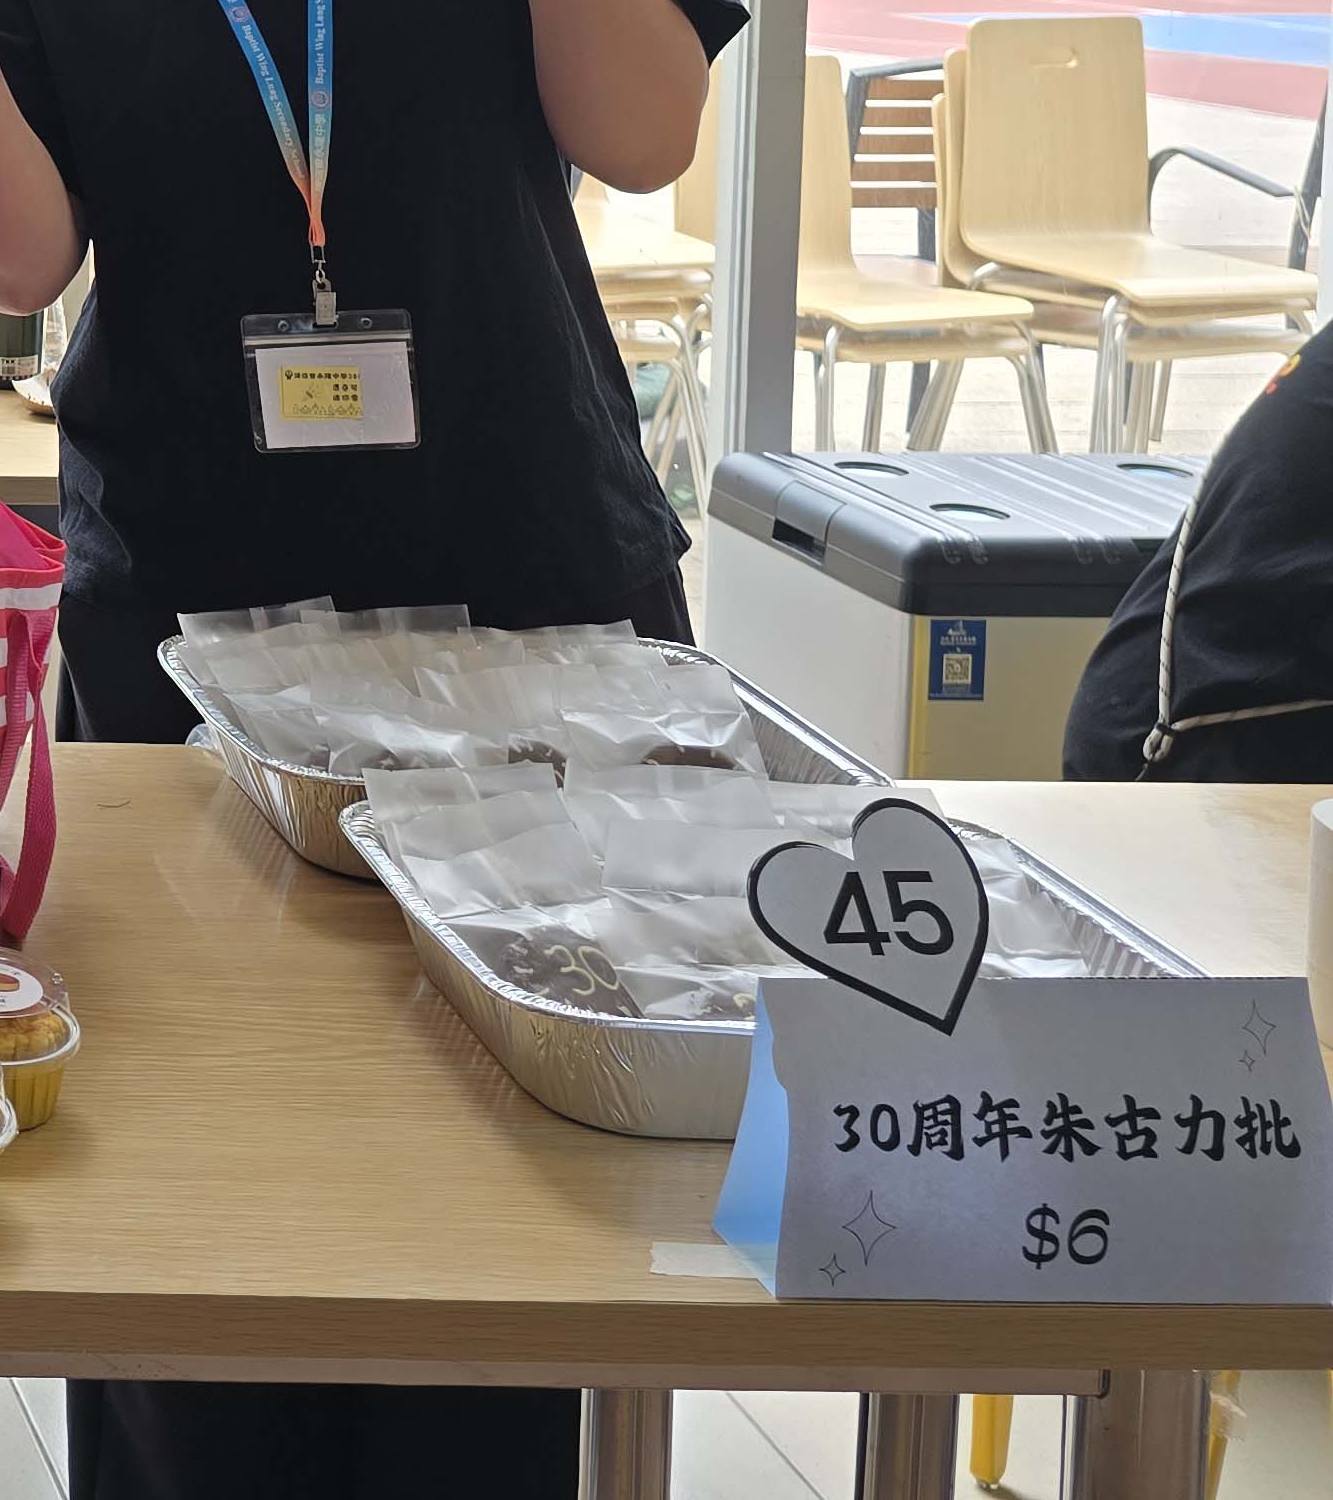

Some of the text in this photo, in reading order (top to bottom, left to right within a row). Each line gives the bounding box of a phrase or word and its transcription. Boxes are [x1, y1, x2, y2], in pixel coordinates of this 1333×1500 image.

[241, 24, 261, 53] Baptist
[255, 52, 272, 78] Wing
[314, 28, 326, 51] Wing
[314, 53, 326, 84] Baptist
[824, 871, 954, 956] 45
[552, 942, 621, 998] 30
[833, 1090, 1302, 1163] 30周年朱古力批
[1022, 1202, 1110, 1269] $6
